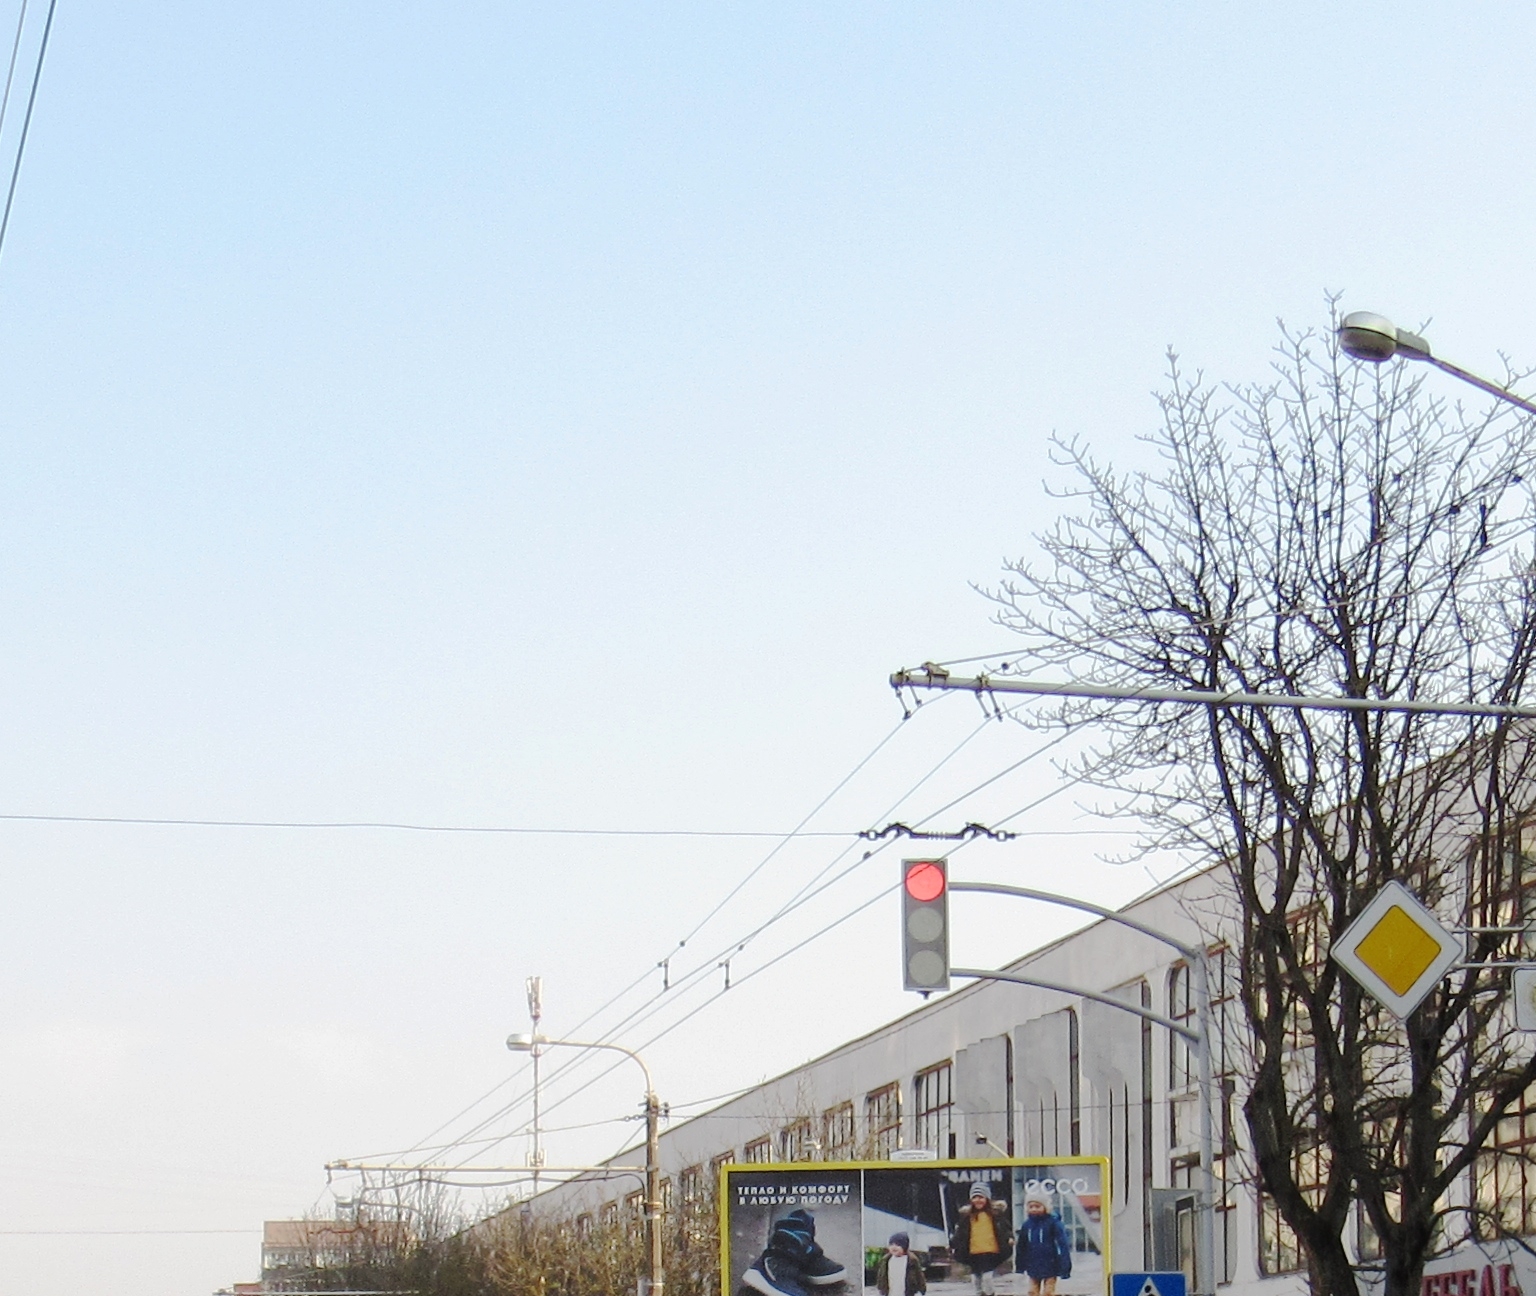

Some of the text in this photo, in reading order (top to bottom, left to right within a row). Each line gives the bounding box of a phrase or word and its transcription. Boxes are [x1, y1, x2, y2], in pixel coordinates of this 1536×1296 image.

[737, 1185, 850, 1195] ТЕПЛО И КОМФОРТ
[1024, 1177, 1088, 1195] ecco
[739, 1194, 849, 1205] В ЛЮБУЮ ПОГОДУ
